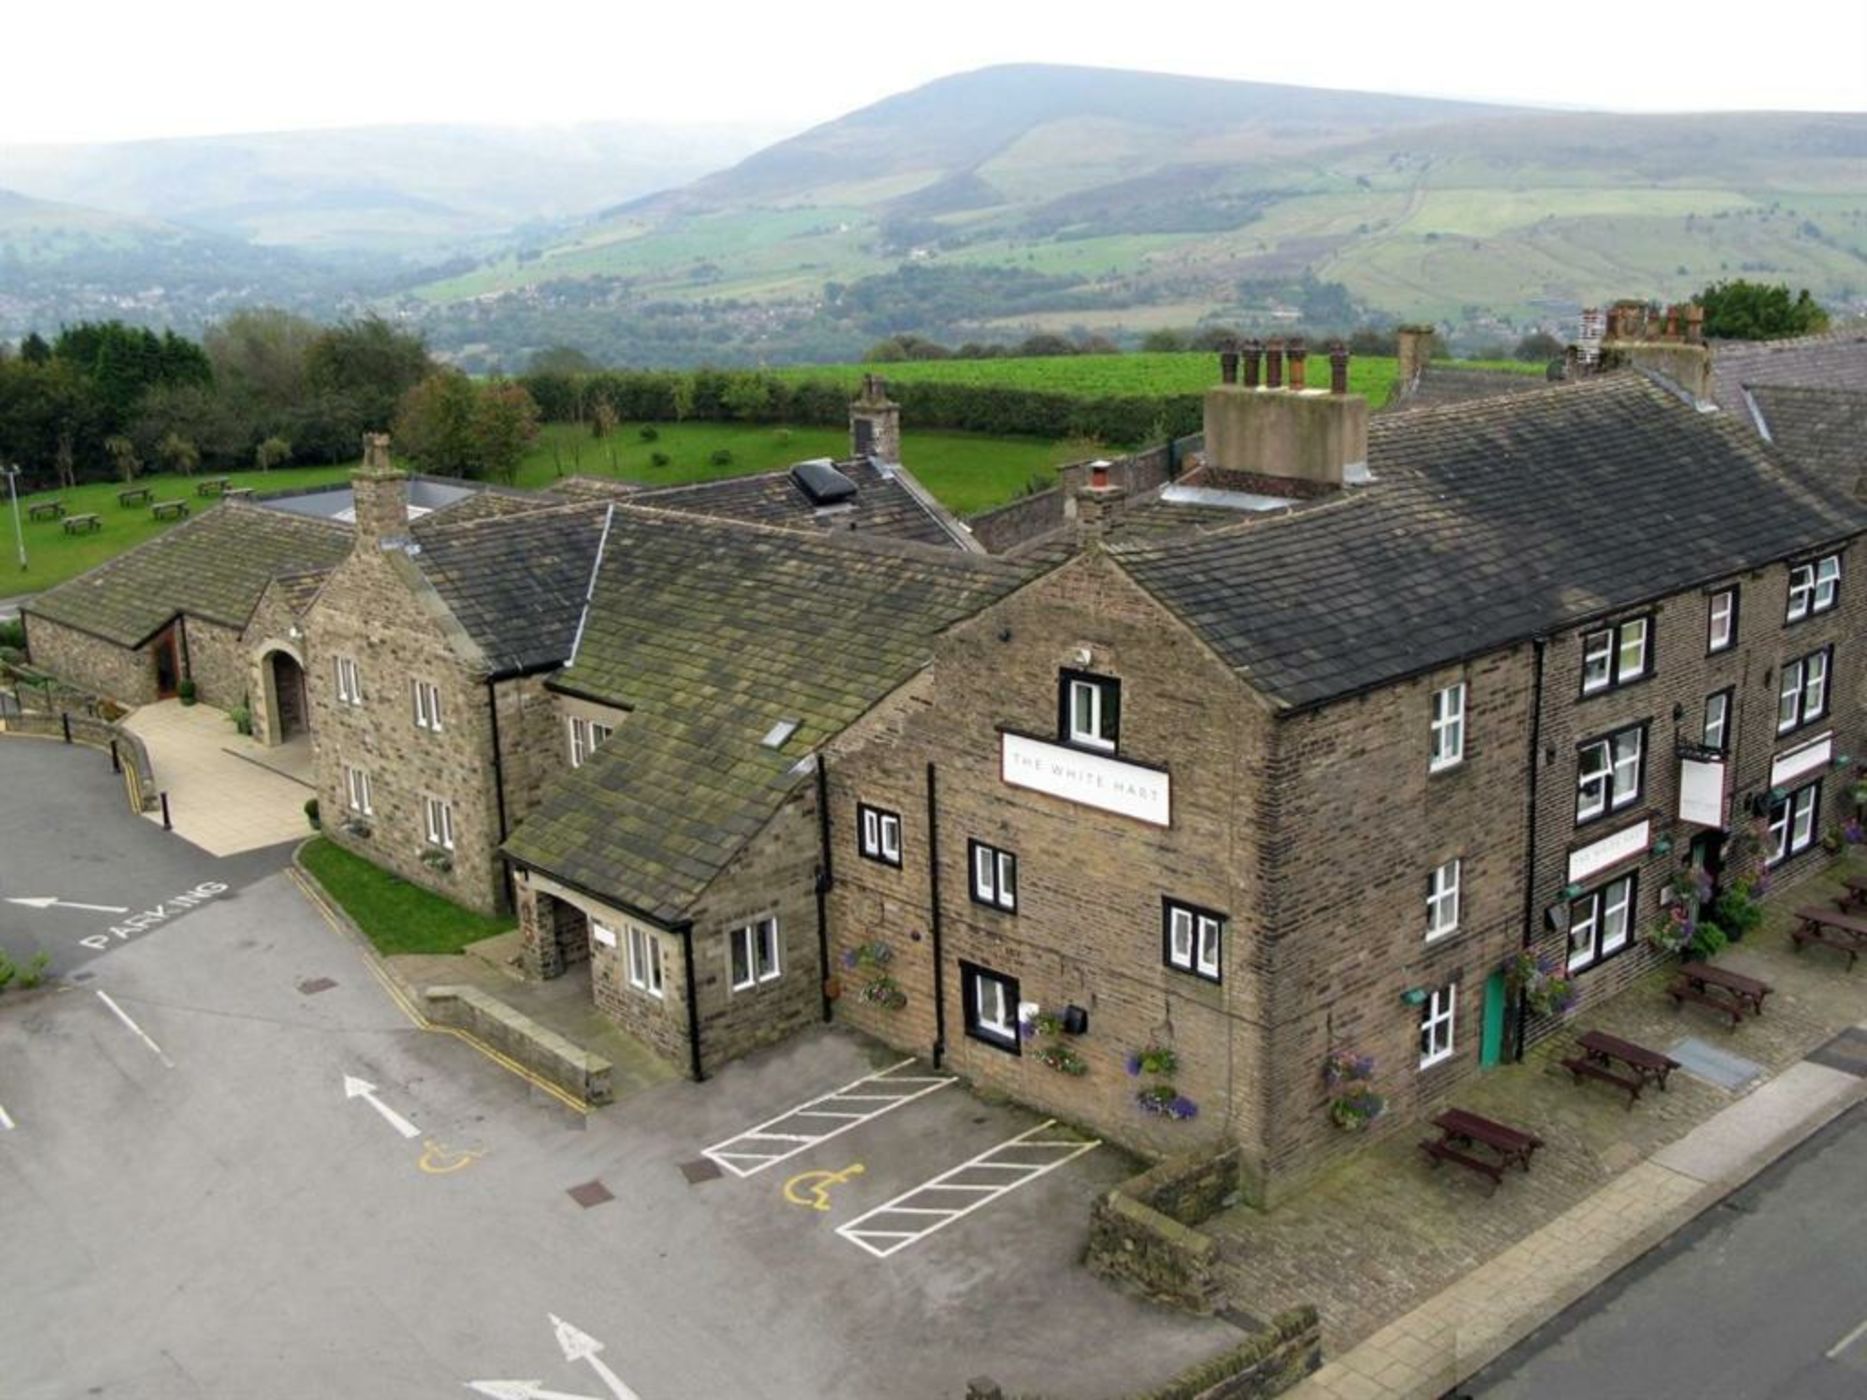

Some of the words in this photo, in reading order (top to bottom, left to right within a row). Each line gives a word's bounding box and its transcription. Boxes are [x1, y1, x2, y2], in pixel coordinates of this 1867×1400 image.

[1014, 753, 1044, 770] THE
[1052, 764, 1103, 788] WHITE
[1113, 782, 1158, 801] HART
[80, 882, 229, 949] PARKING
